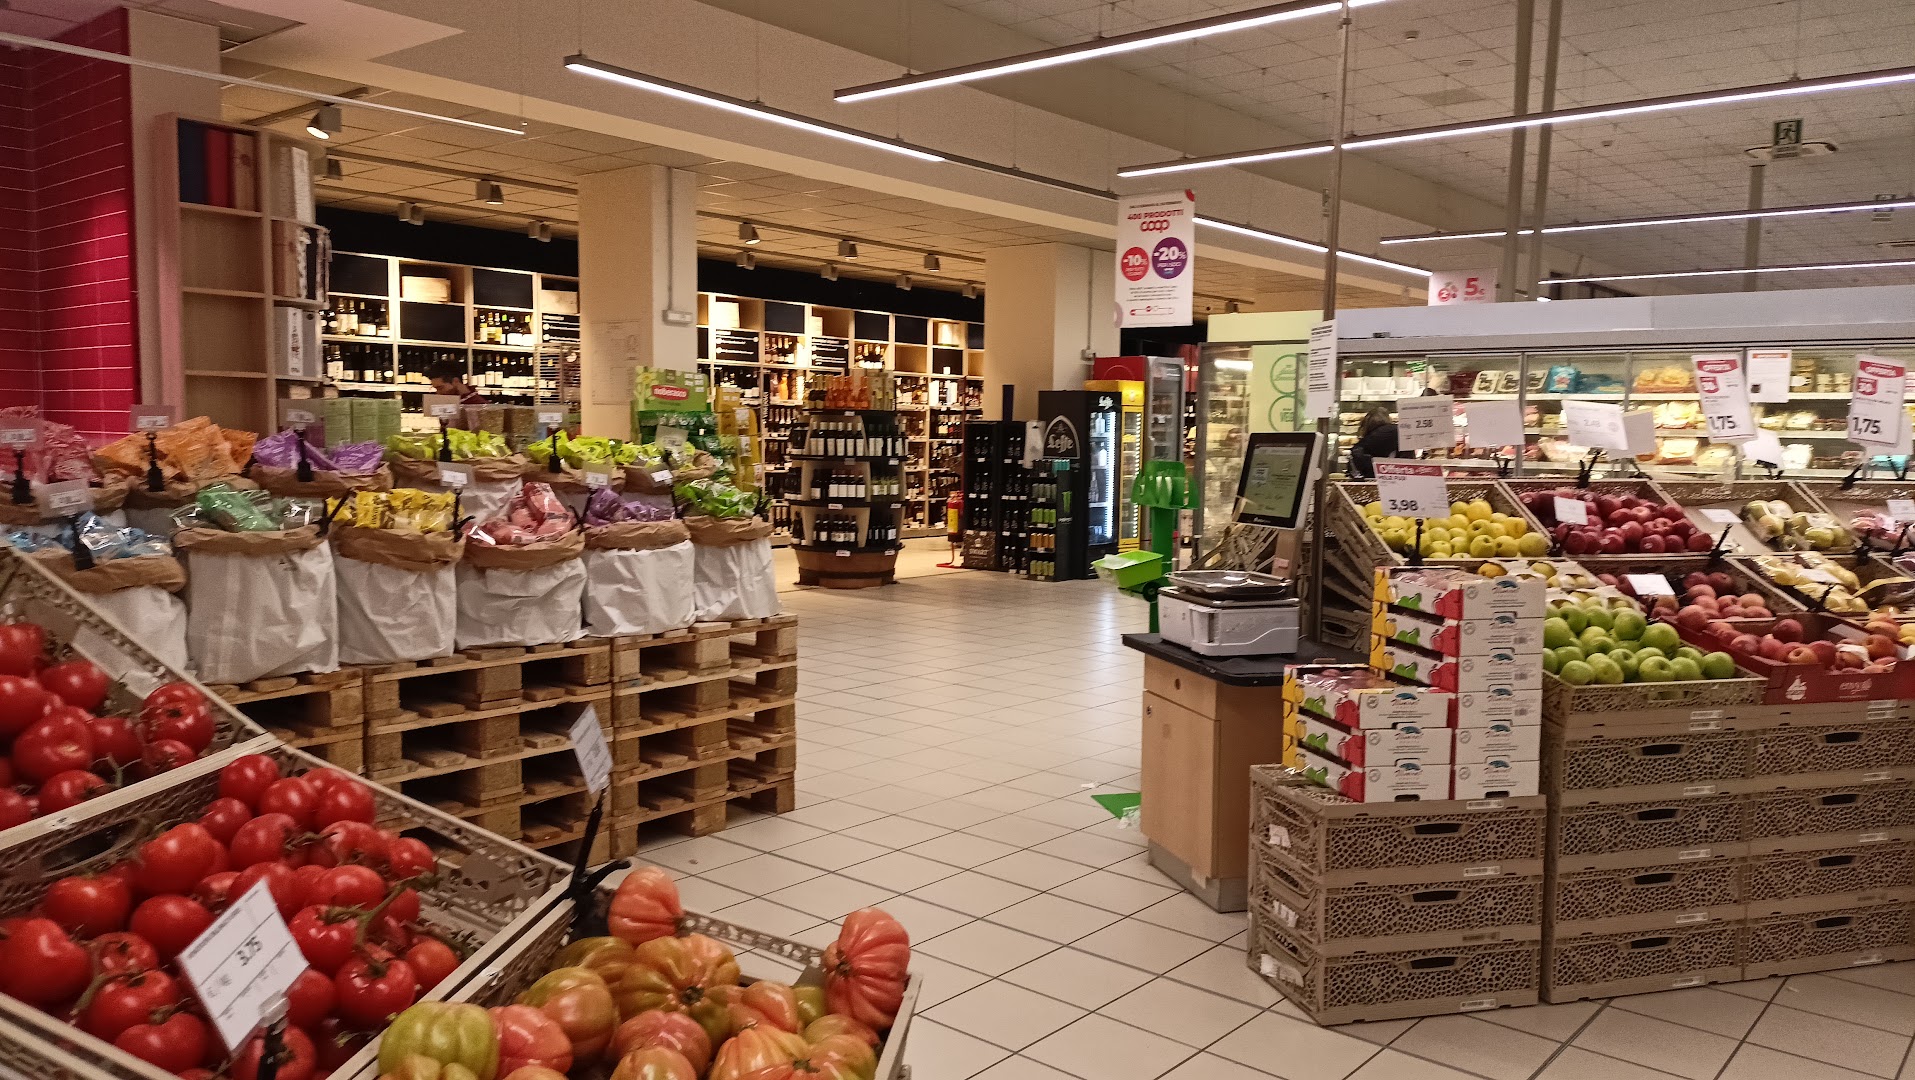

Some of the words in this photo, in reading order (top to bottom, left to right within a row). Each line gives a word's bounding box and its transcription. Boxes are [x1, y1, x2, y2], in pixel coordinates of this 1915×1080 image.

[1144, 209, 1184, 219] PRODOTTI
[1153, 246, 1187, 261] -20%
[1852, 416, 1881, 435] 1,75
[1046, 433, 1074, 454] Leffe
[1388, 499, 1419, 512] 3,98
